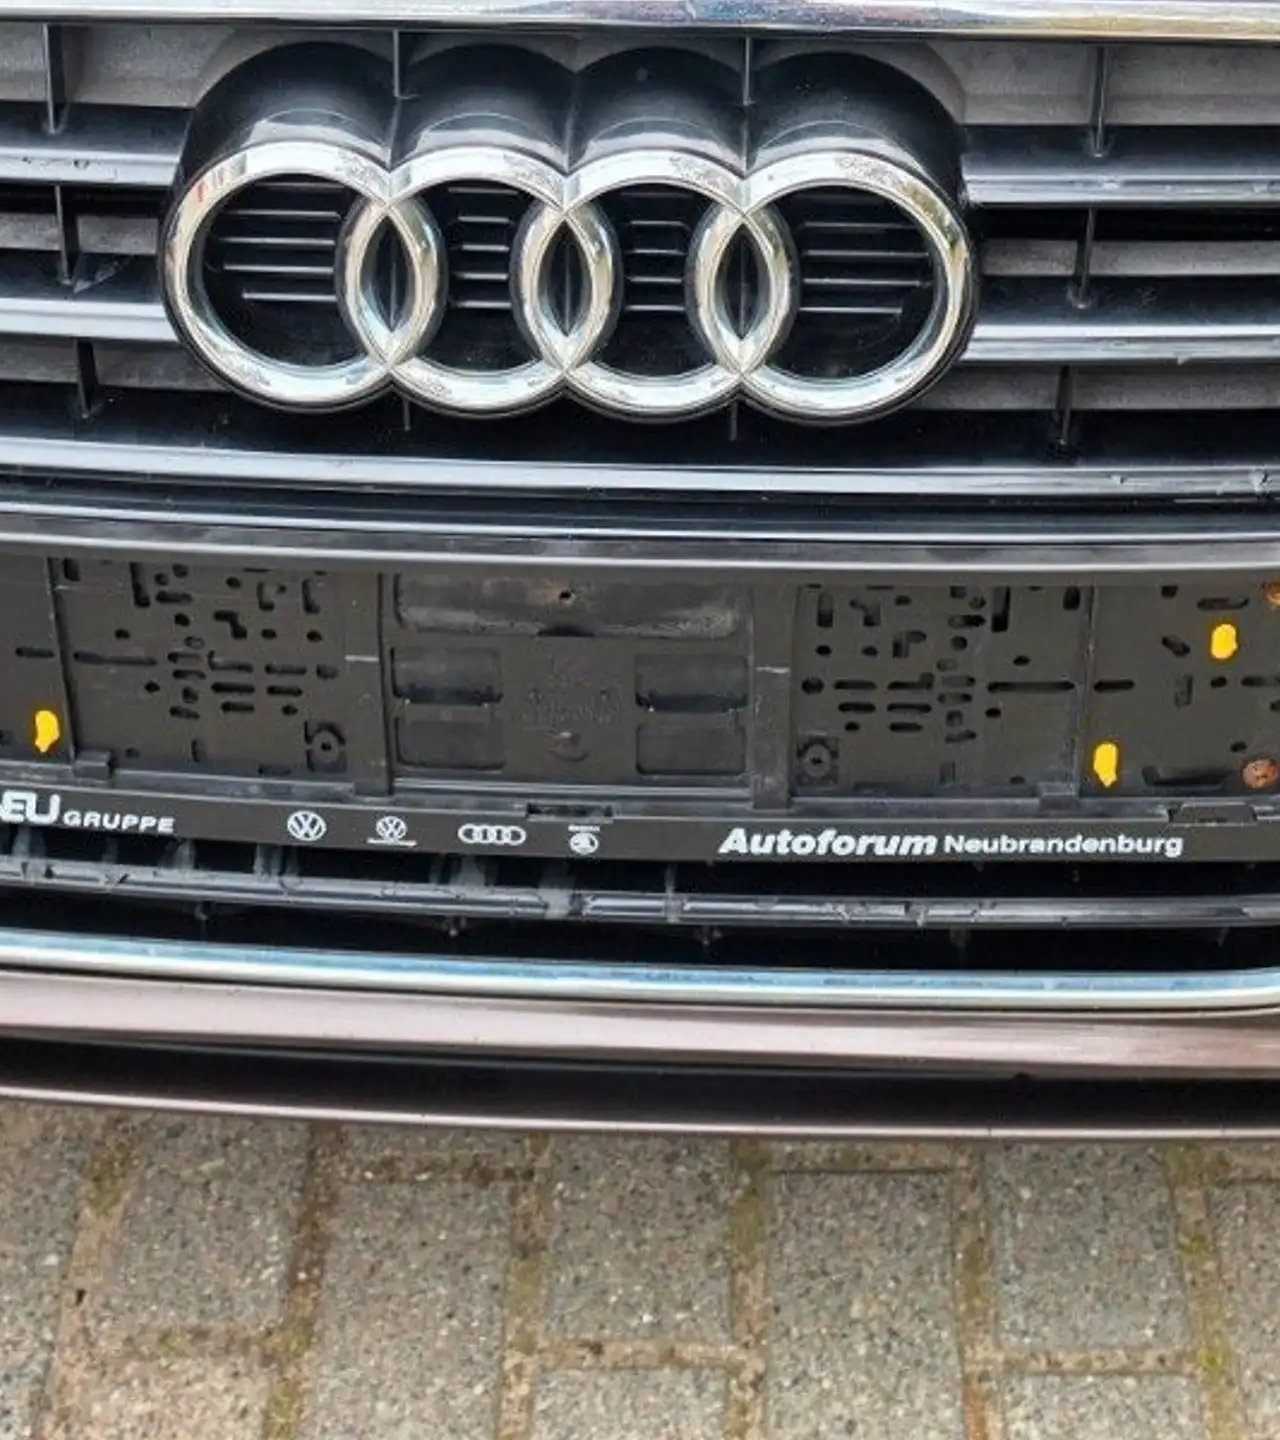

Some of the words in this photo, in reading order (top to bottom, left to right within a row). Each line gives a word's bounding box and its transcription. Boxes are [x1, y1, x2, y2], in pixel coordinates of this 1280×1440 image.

[63, 810, 176, 834] GRUPPE
[718, 827, 938, 856] Autoforum
[944, 833, 1184, 858] Neubrandenburg
